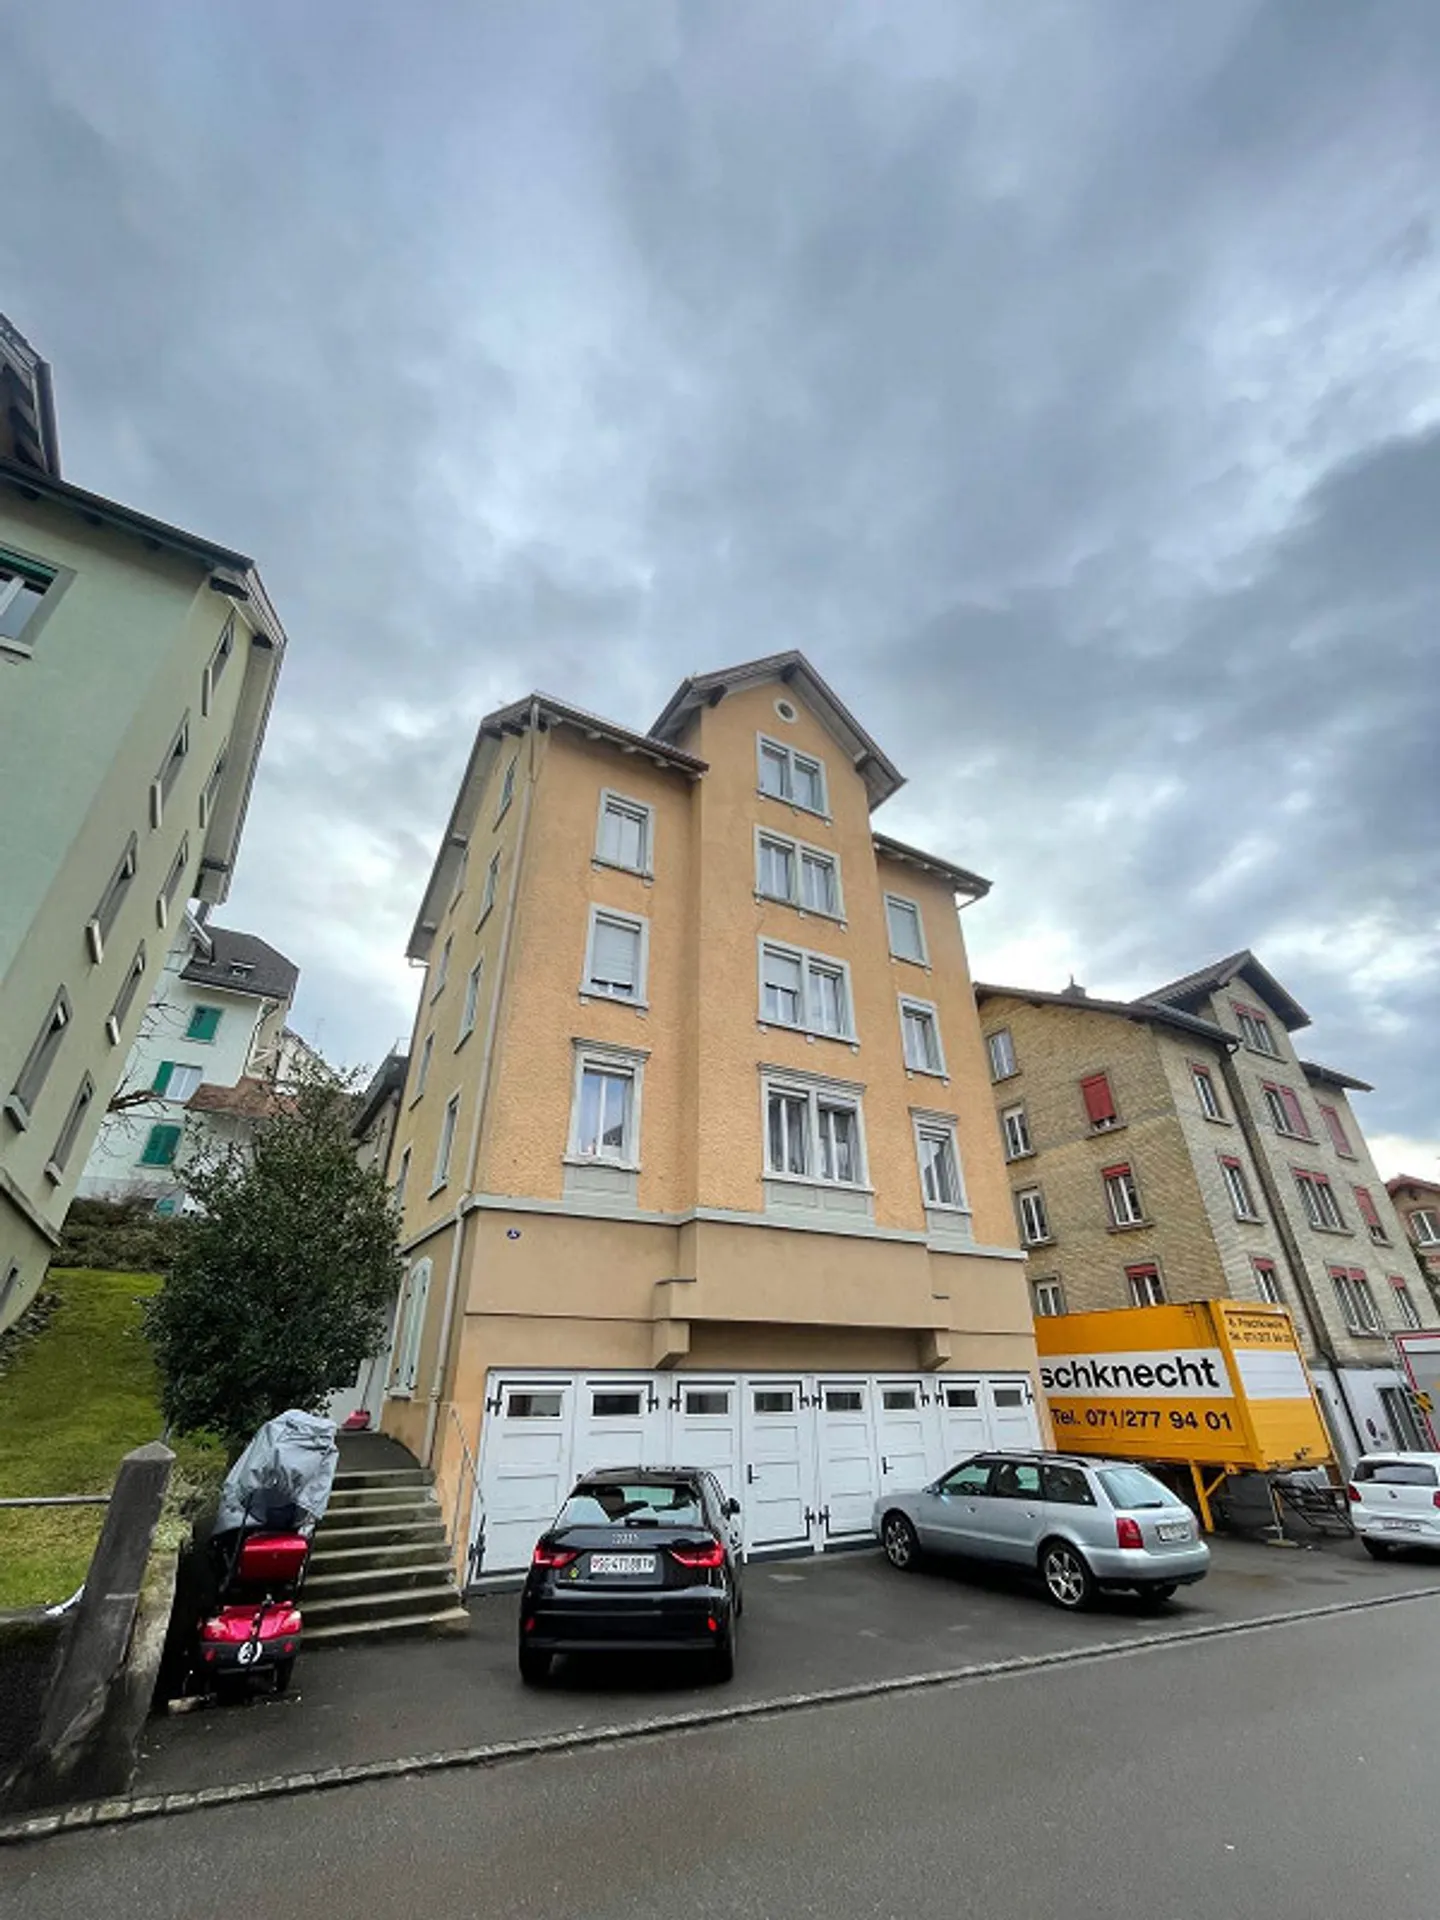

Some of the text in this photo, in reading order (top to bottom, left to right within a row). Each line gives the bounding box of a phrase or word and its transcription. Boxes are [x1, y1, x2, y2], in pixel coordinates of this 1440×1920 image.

[1051, 1408, 1232, 1431] Tel. 071/277 94 01
